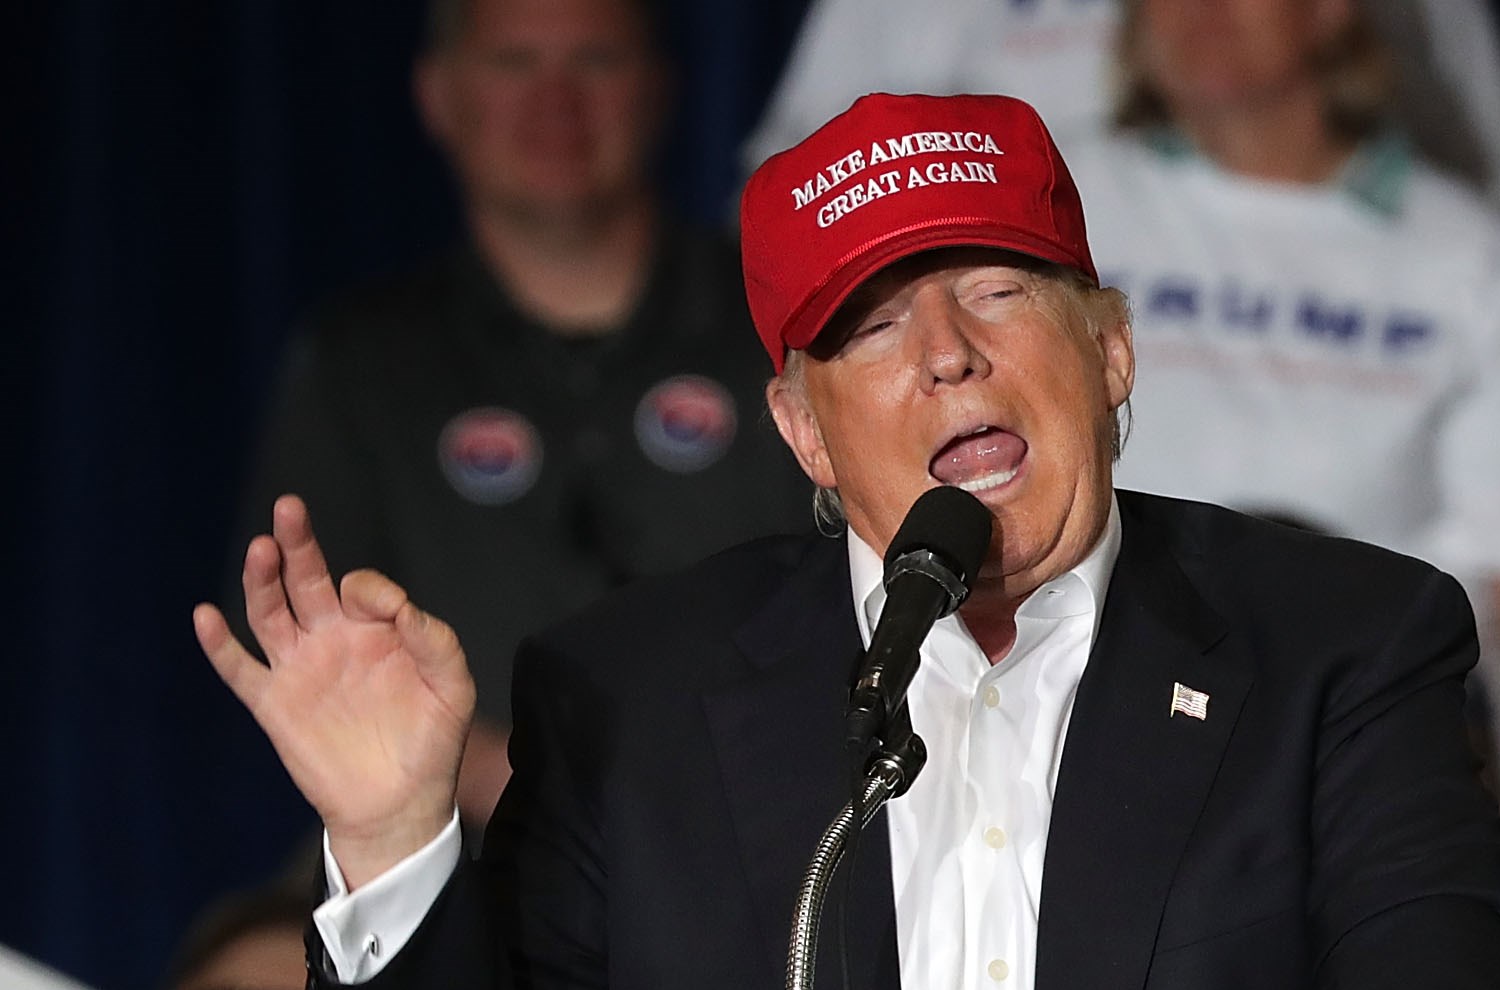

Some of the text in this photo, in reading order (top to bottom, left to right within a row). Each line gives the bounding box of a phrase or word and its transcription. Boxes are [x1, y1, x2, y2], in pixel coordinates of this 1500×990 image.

[791, 131, 1004, 211] MAKE AMERICA
[816, 160, 999, 229] GREAT AGAIN
